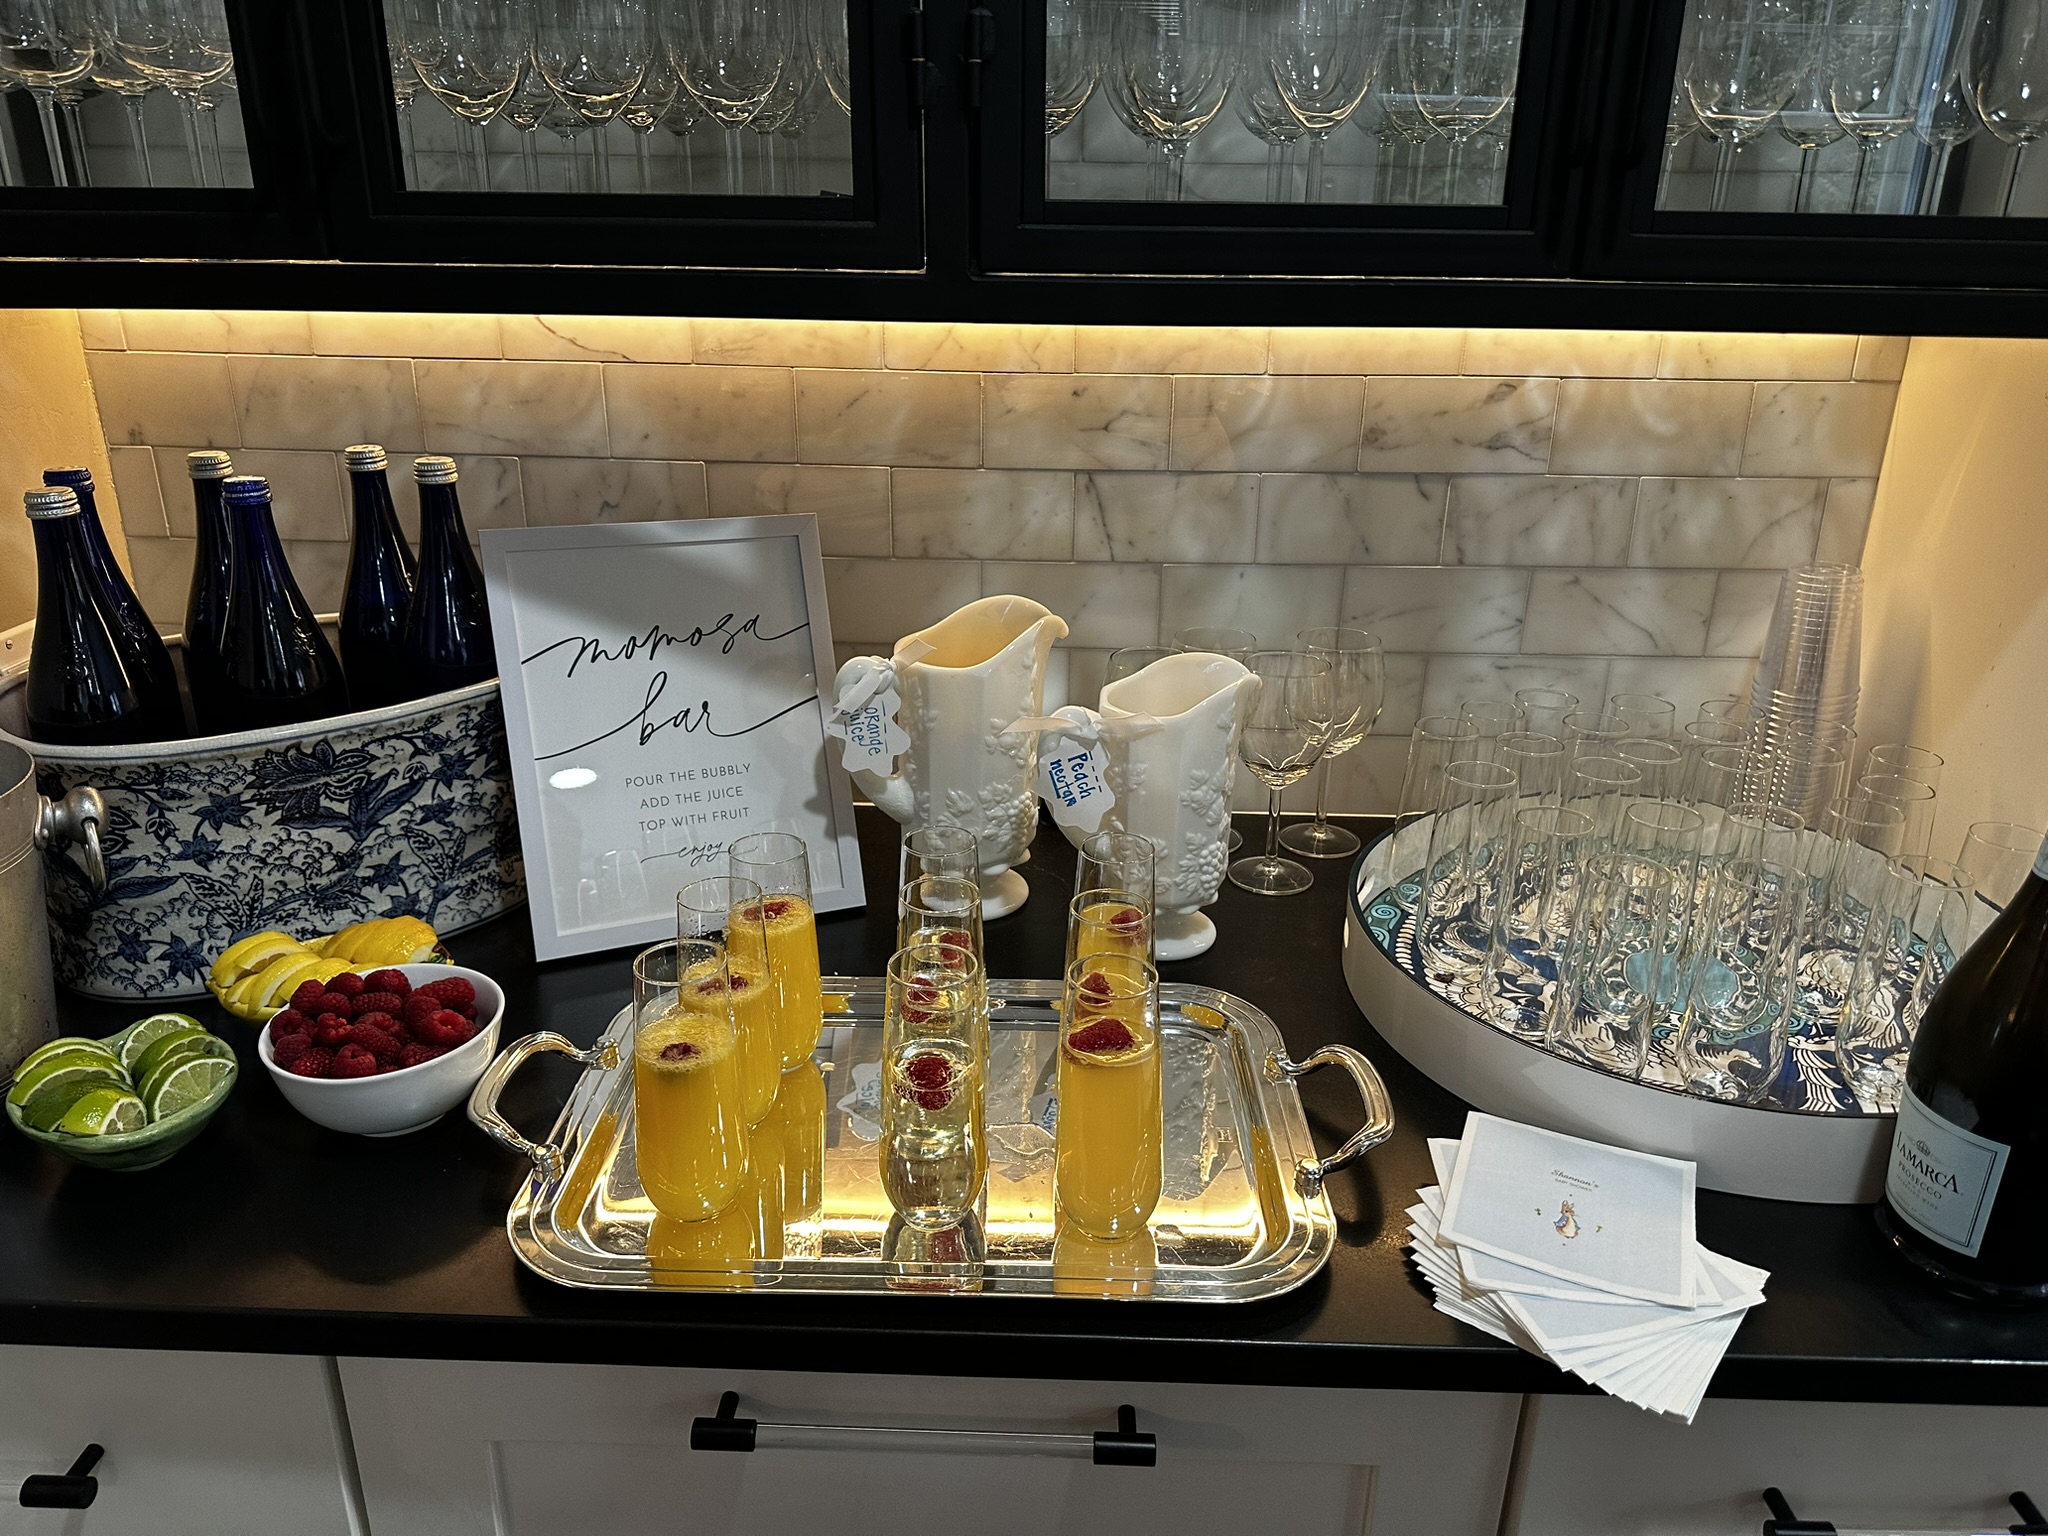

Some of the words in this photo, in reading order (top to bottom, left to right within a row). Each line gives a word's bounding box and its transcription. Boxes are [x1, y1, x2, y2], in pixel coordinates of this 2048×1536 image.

[625, 773, 664, 788] POUR
[669, 769, 696, 782] THE
[701, 763, 751, 779] BUBBLY
[1067, 751, 1096, 800] Peach
[640, 795, 670, 809] ADD
[675, 791, 702, 804] THE
[707, 785, 744, 802] JUICE
[638, 818, 666, 832] TOP
[671, 813, 707, 827] WITH
[712, 807, 750, 822] FRUIT
[664, 841, 732, 868] enjoy
[1550, 1169, 1600, 1189] Shannon's
[1898, 1160, 1942, 1200] PROSECCO
